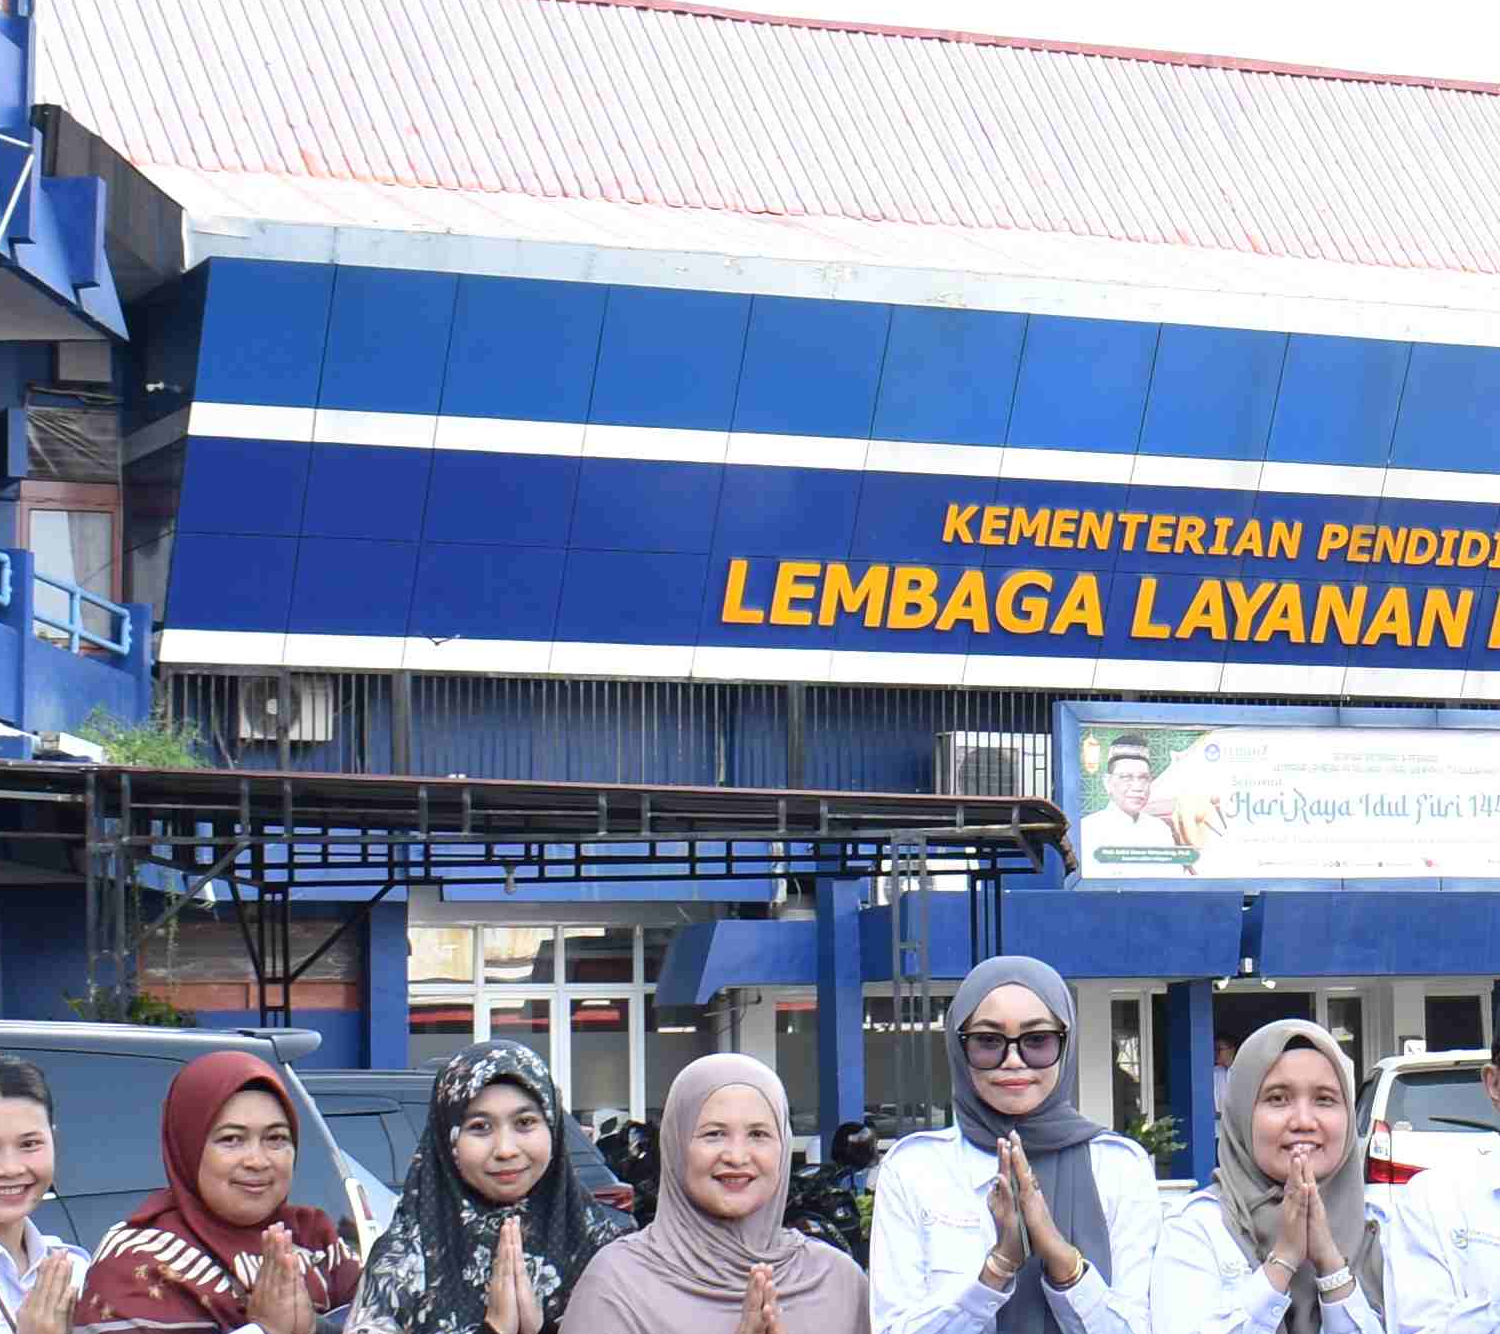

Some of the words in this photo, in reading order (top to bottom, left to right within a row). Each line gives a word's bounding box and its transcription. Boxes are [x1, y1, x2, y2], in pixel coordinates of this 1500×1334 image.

[942, 504, 1303, 559] KEMENTERIAN
[721, 558, 1105, 636] LEMBAGA
[1130, 577, 1474, 648] LAYANAN
[1226, 791, 1286, 824] Hari
[1284, 788, 1354, 824] Raya
[1358, 793, 1409, 818] Idul
